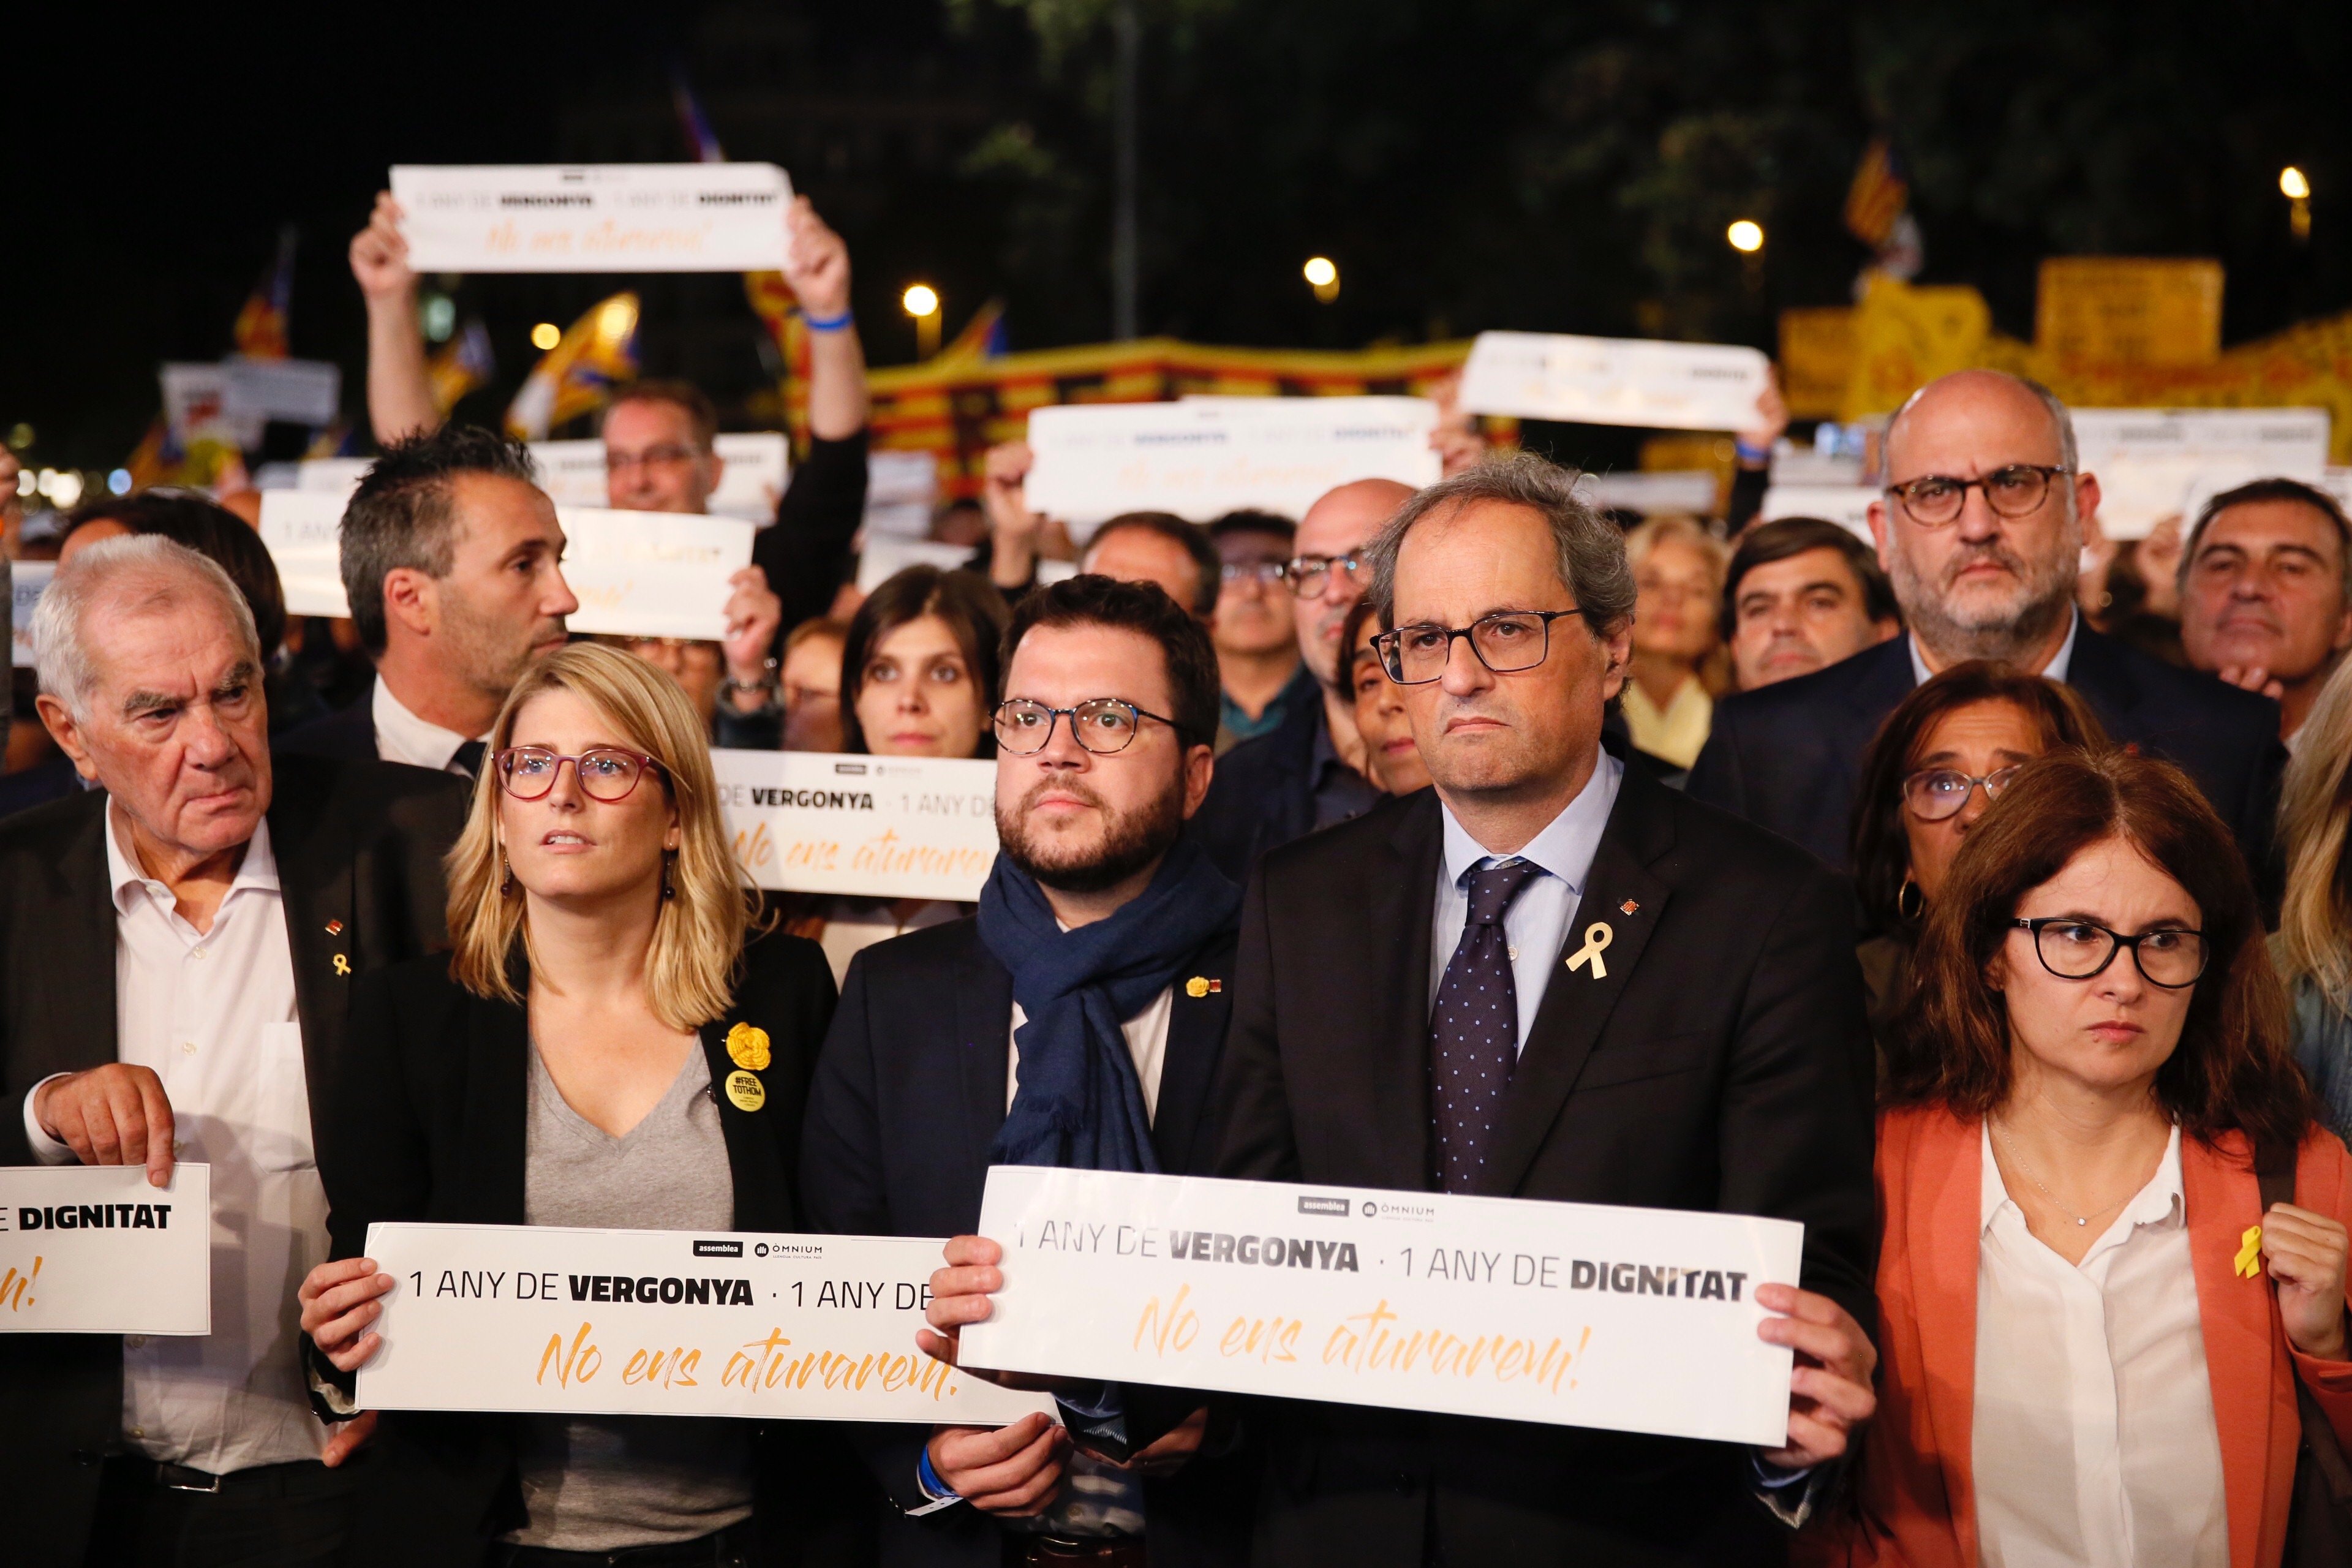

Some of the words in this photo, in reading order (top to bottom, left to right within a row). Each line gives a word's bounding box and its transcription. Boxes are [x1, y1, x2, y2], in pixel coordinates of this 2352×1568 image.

[752, 788, 875, 810] VERGONYA
[916, 792, 965, 817] ANY
[731, 820, 774, 867] No
[785, 838, 839, 872] ens
[733, 1085, 762, 1096] TOTHOM
[735, 1076, 757, 1087] #FREE
[18, 1204, 172, 1231] DIGNITAT
[1303, 1200, 1346, 1212] assemblea
[698, 1244, 739, 1253] assemblea
[772, 1243, 823, 1254] ÒMNIUM
[1038, 1220, 1106, 1253] ANY
[1116, 1225, 1159, 1257] DE
[1169, 1230, 1359, 1273] VERGONYA
[1400, 1248, 1412, 1277] 1
[1427, 1248, 1501, 1283] ANY
[1513, 1254, 1560, 1288] DE
[1570, 1259, 1748, 1302] DIGNITAT
[409, 1271, 422, 1297] 1
[435, 1270, 506, 1298] ANY
[516, 1272, 559, 1300] DE
[568, 1275, 754, 1306] VERGONYA
[791, 1281, 803, 1307] 1
[816, 1281, 885, 1309] ANY
[1133, 1283, 1200, 1359] No
[1219, 1316, 1303, 1365] ens
[1322, 1298, 1592, 1395] aturarem!
[537, 1321, 602, 1390] No
[622, 1347, 701, 1390] ens
